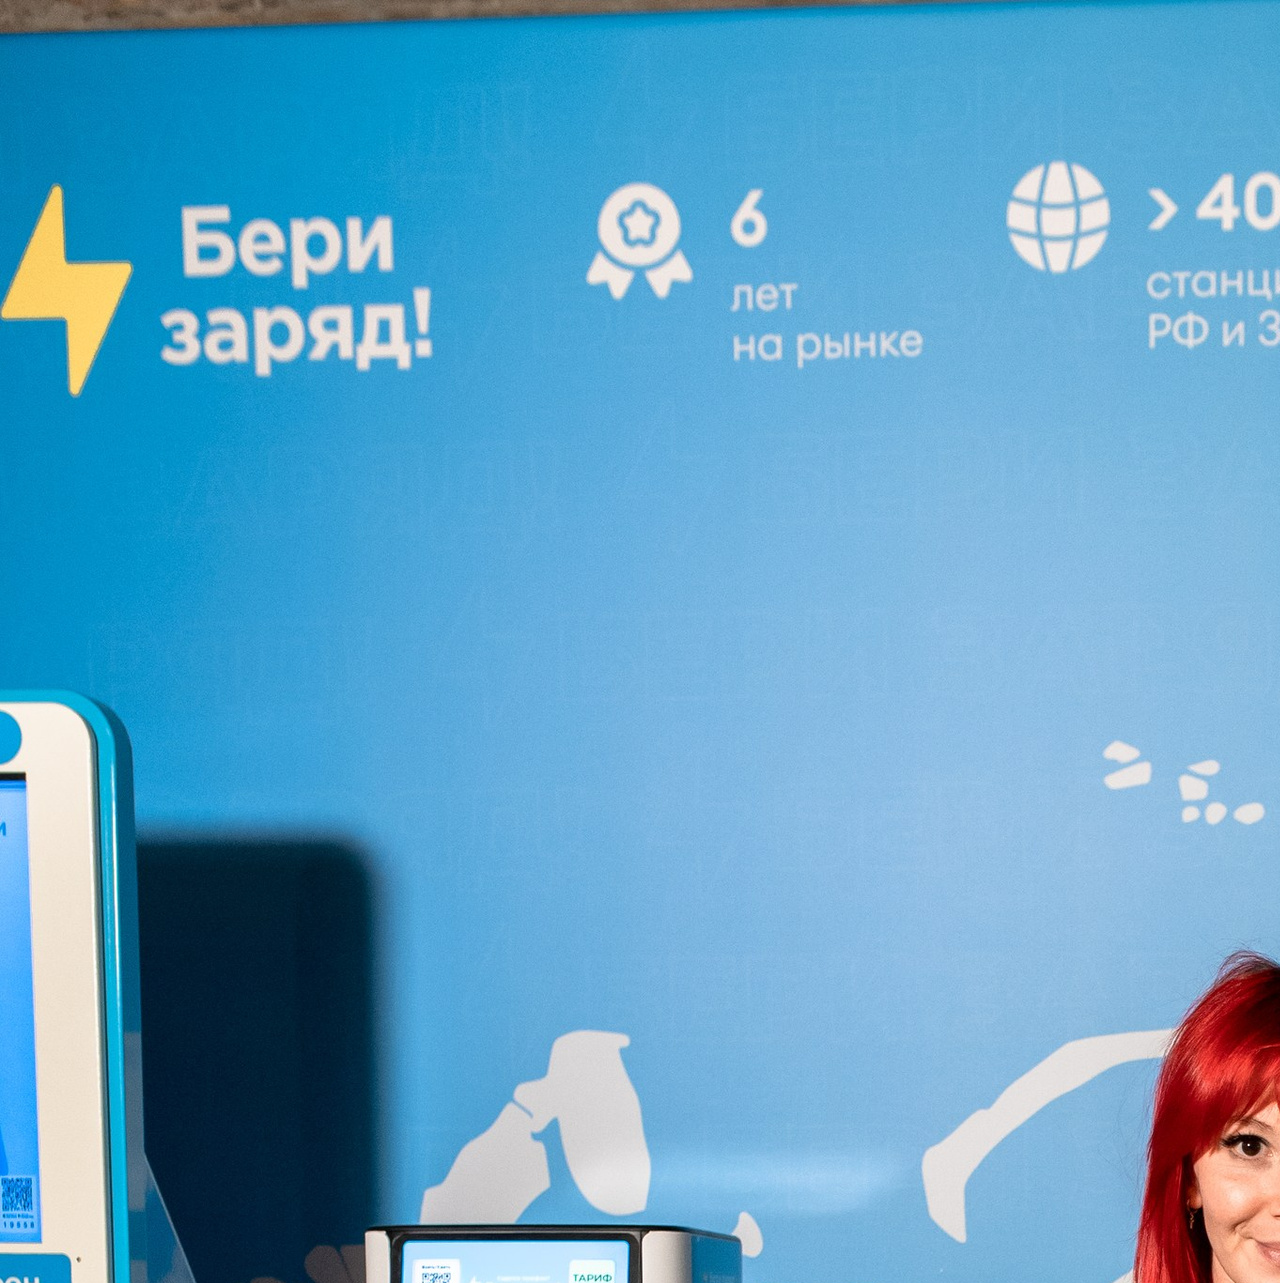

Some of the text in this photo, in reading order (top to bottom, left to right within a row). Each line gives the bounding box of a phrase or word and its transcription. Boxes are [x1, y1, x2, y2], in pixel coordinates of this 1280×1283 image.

[731, 189, 767, 247] 6
[182, 205, 394, 289] Бери
[731, 283, 798, 312] лет
[161, 288, 433, 377] заряд!
[733, 330, 923, 368] на рынке
[1149, 312, 1209, 349] РФ
[1222, 321, 1245, 346] и
[573, 1274, 612, 1283] ТАРИФ
